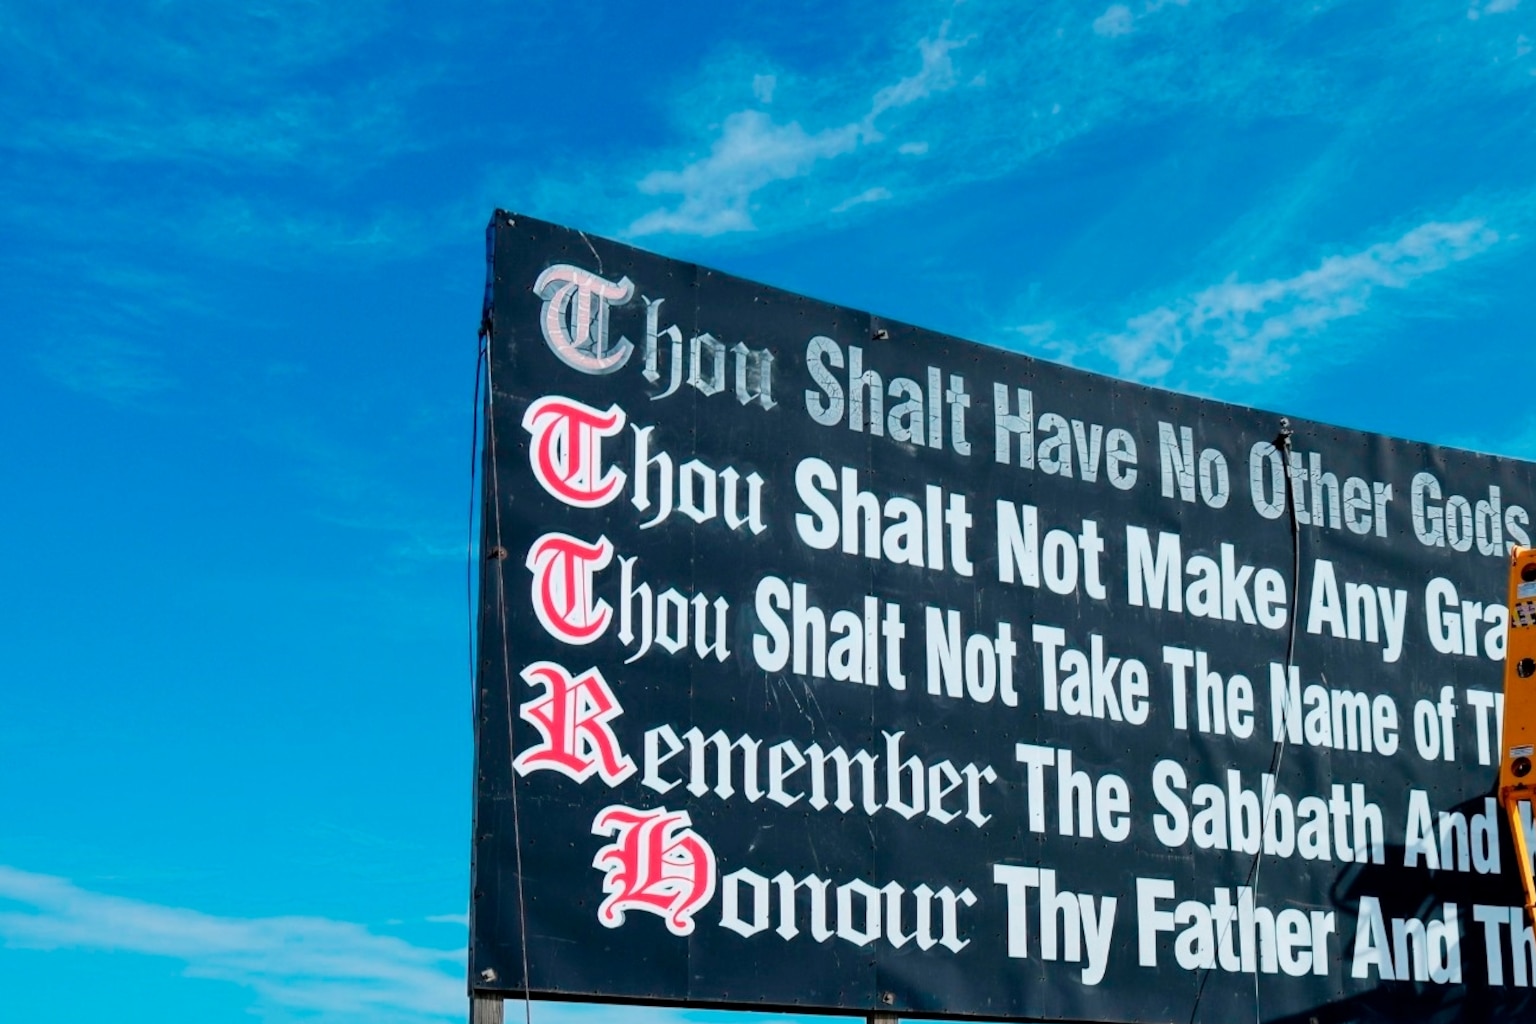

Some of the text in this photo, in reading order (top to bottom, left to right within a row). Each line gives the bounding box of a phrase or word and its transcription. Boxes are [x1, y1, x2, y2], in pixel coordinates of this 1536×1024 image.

[533, 263, 777, 412] Thou
[806, 335, 971, 456] Shalt
[993, 382, 1138, 490] Have
[1158, 420, 1229, 509] No
[1250, 441, 1394, 538] Other
[1411, 472, 1532, 557] Gods
[521, 395, 767, 535] Thou
[795, 458, 973, 577] Shalt
[996, 499, 1106, 600] Not
[1126, 525, 1288, 630] Make
[1307, 559, 1409, 663] Any
[525, 531, 730, 665] Thou
[753, 575, 906, 691] Shalt
[926, 606, 1018, 707] Not
[1032, 624, 1150, 726] Take
[1163, 646, 1255, 739] The
[1271, 662, 1399, 757] Name
[1414, 685, 1457, 762] of
[513, 661, 997, 829] Remember
[1016, 742, 1131, 843] The
[1152, 759, 1386, 865] Sabbath
[1404, 790, 1502, 875] And
[591, 804, 978, 954] Honour
[993, 864, 1117, 986] Thy
[1135, 877, 1336, 977] Father
[1352, 895, 1462, 985] And
